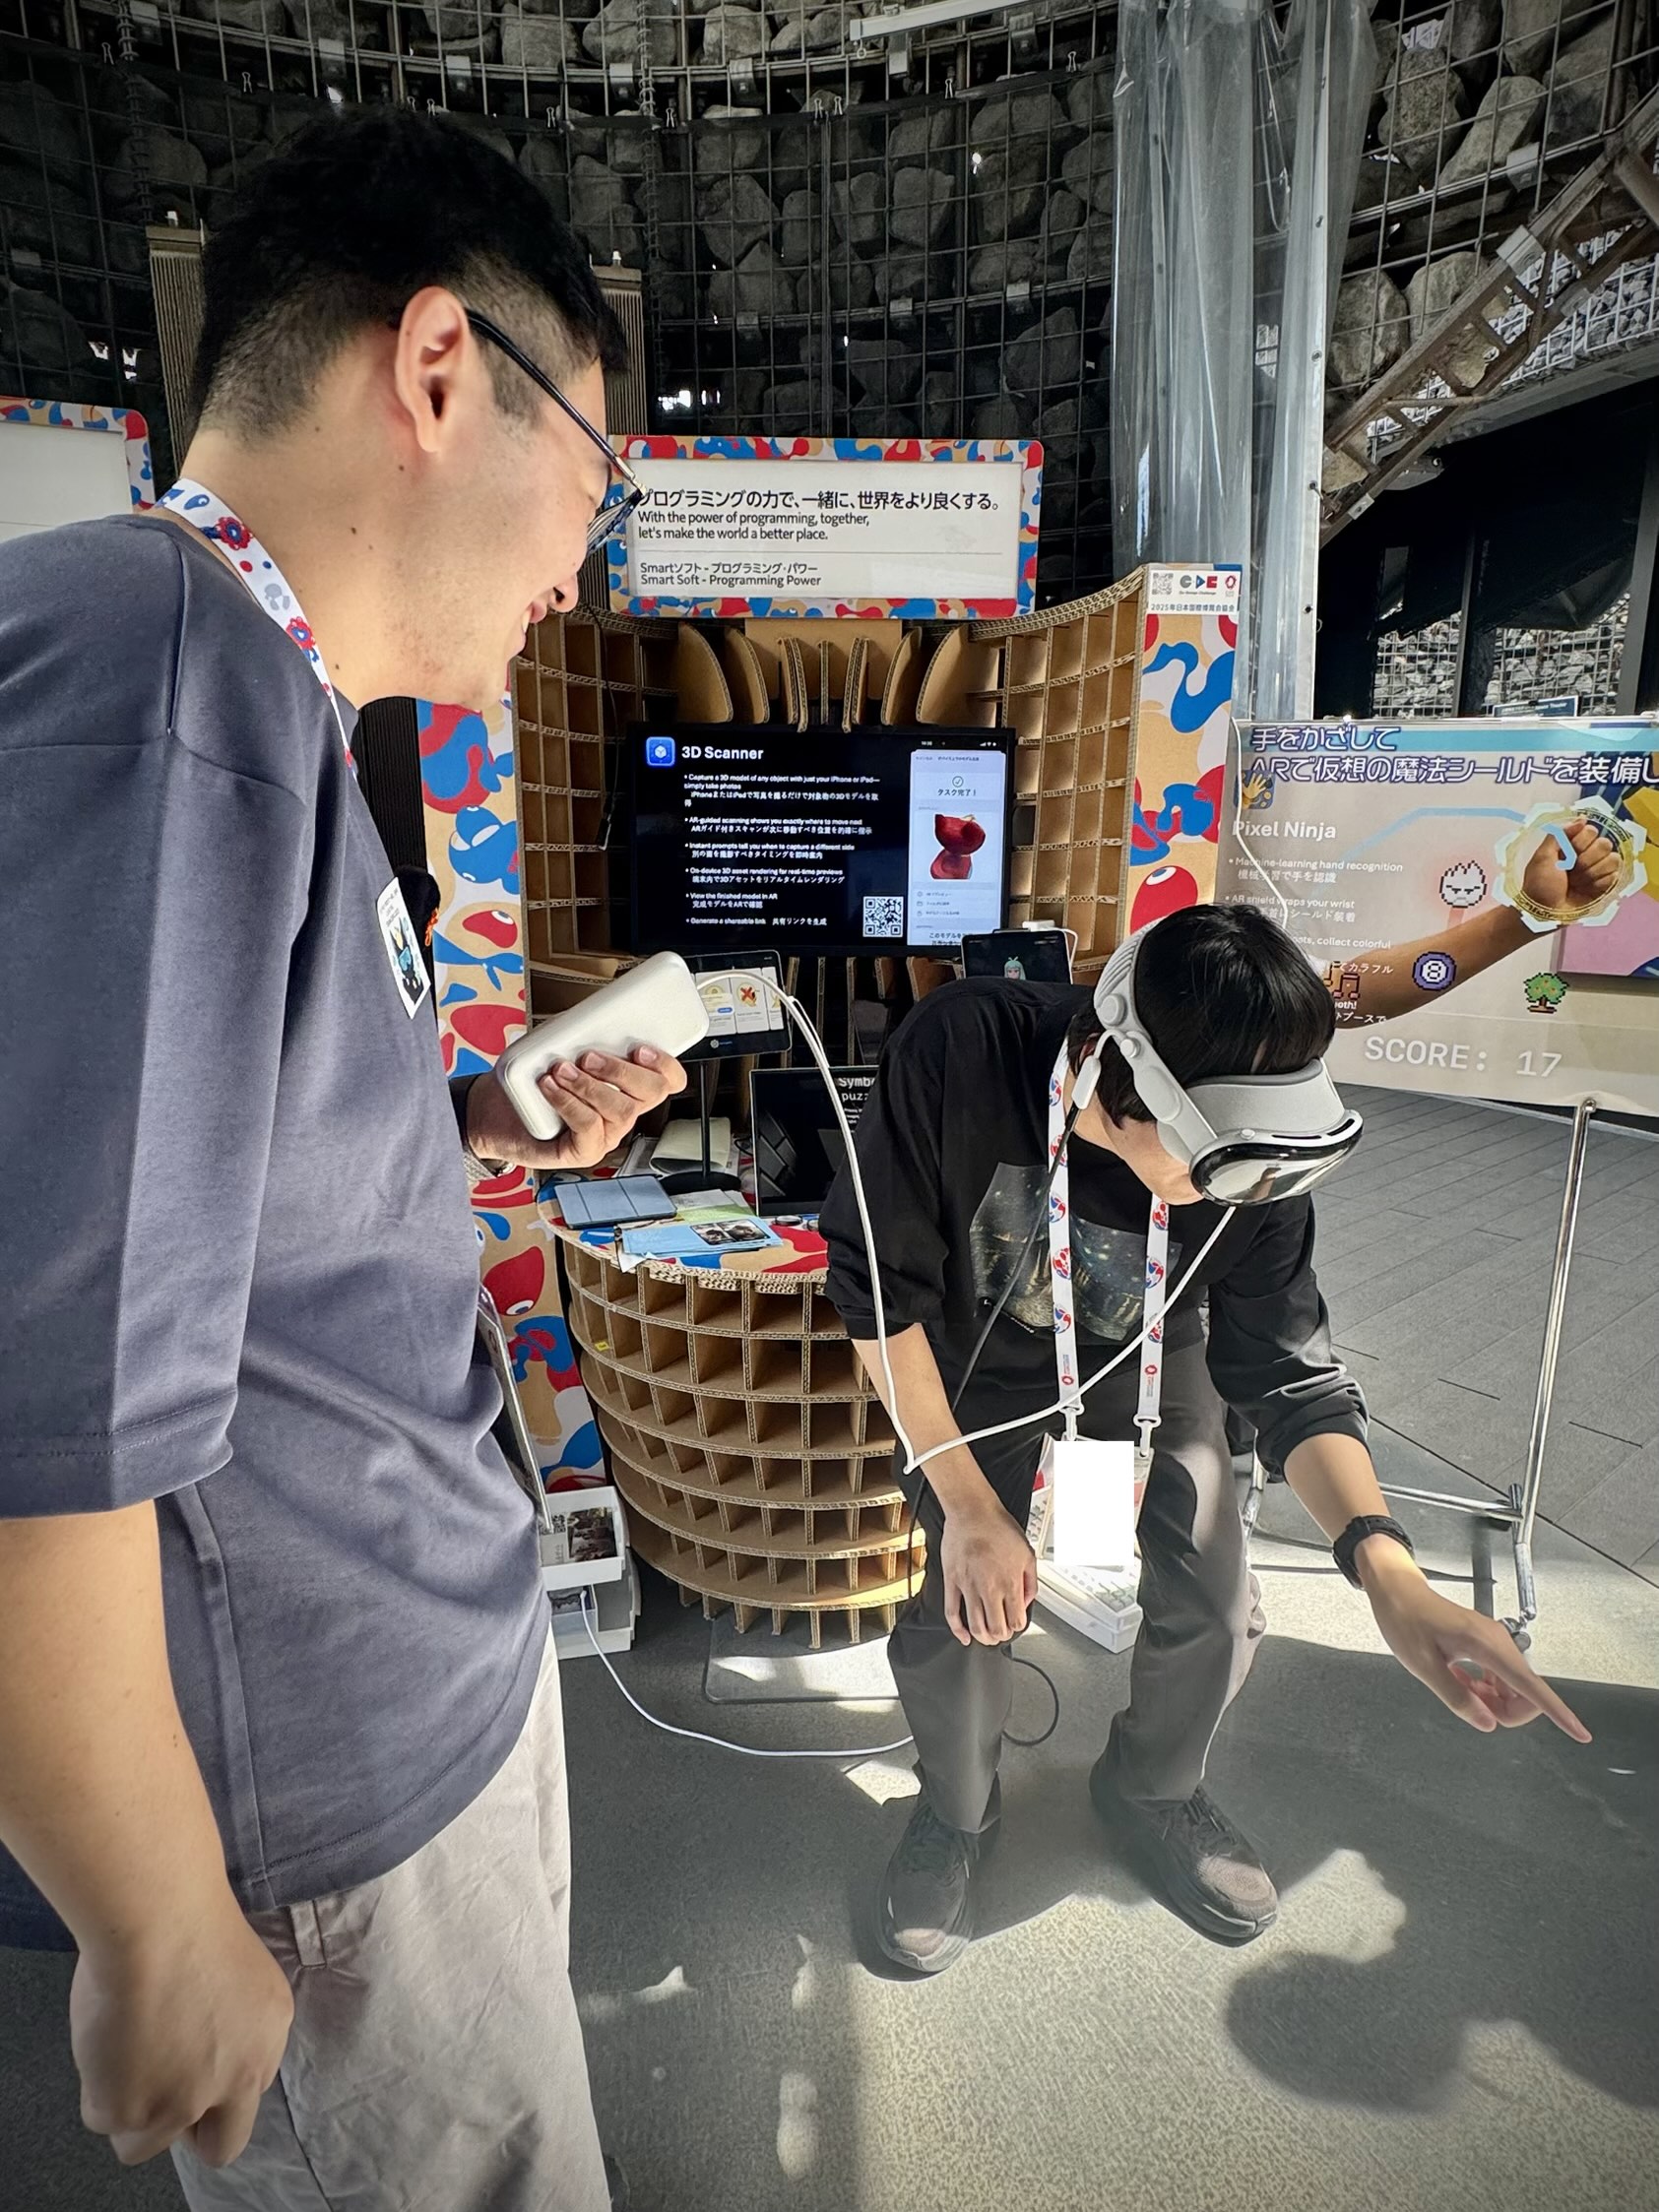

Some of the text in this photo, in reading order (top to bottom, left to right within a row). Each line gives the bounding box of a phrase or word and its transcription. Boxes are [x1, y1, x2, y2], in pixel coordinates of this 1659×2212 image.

[638, 511, 869, 527] With the power of programming, together,
[638, 527, 662, 539] let's
[664, 528, 694, 539] make
[696, 527, 715, 539] the
[717, 527, 748, 539] world
[760, 528, 795, 540] better
[796, 528, 828, 541] place.
[640, 562, 701, 574] Smartソフト
[641, 574, 673, 586] Smart
[677, 574, 699, 586] Soft
[709, 576, 784, 588] Programming
[787, 576, 821, 586] Power
[1251, 727, 1401, 751] 手をかざして
[681, 746, 764, 759] 3D Scanner
[1233, 821, 1336, 842] Pixel Ninja
[1319, 859, 1344, 869] hand
[1346, 860, 1403, 872] recognition
[1232, 894, 1244, 903] AR
[1246, 895, 1275, 905] shield
[1307, 899, 1329, 908] your
[1330, 899, 1355, 909] wrist
[1316, 937, 1351, 947] collect
[1353, 939, 1391, 949] colorful
[1365, 1036, 1563, 1078] SCORE: 17
